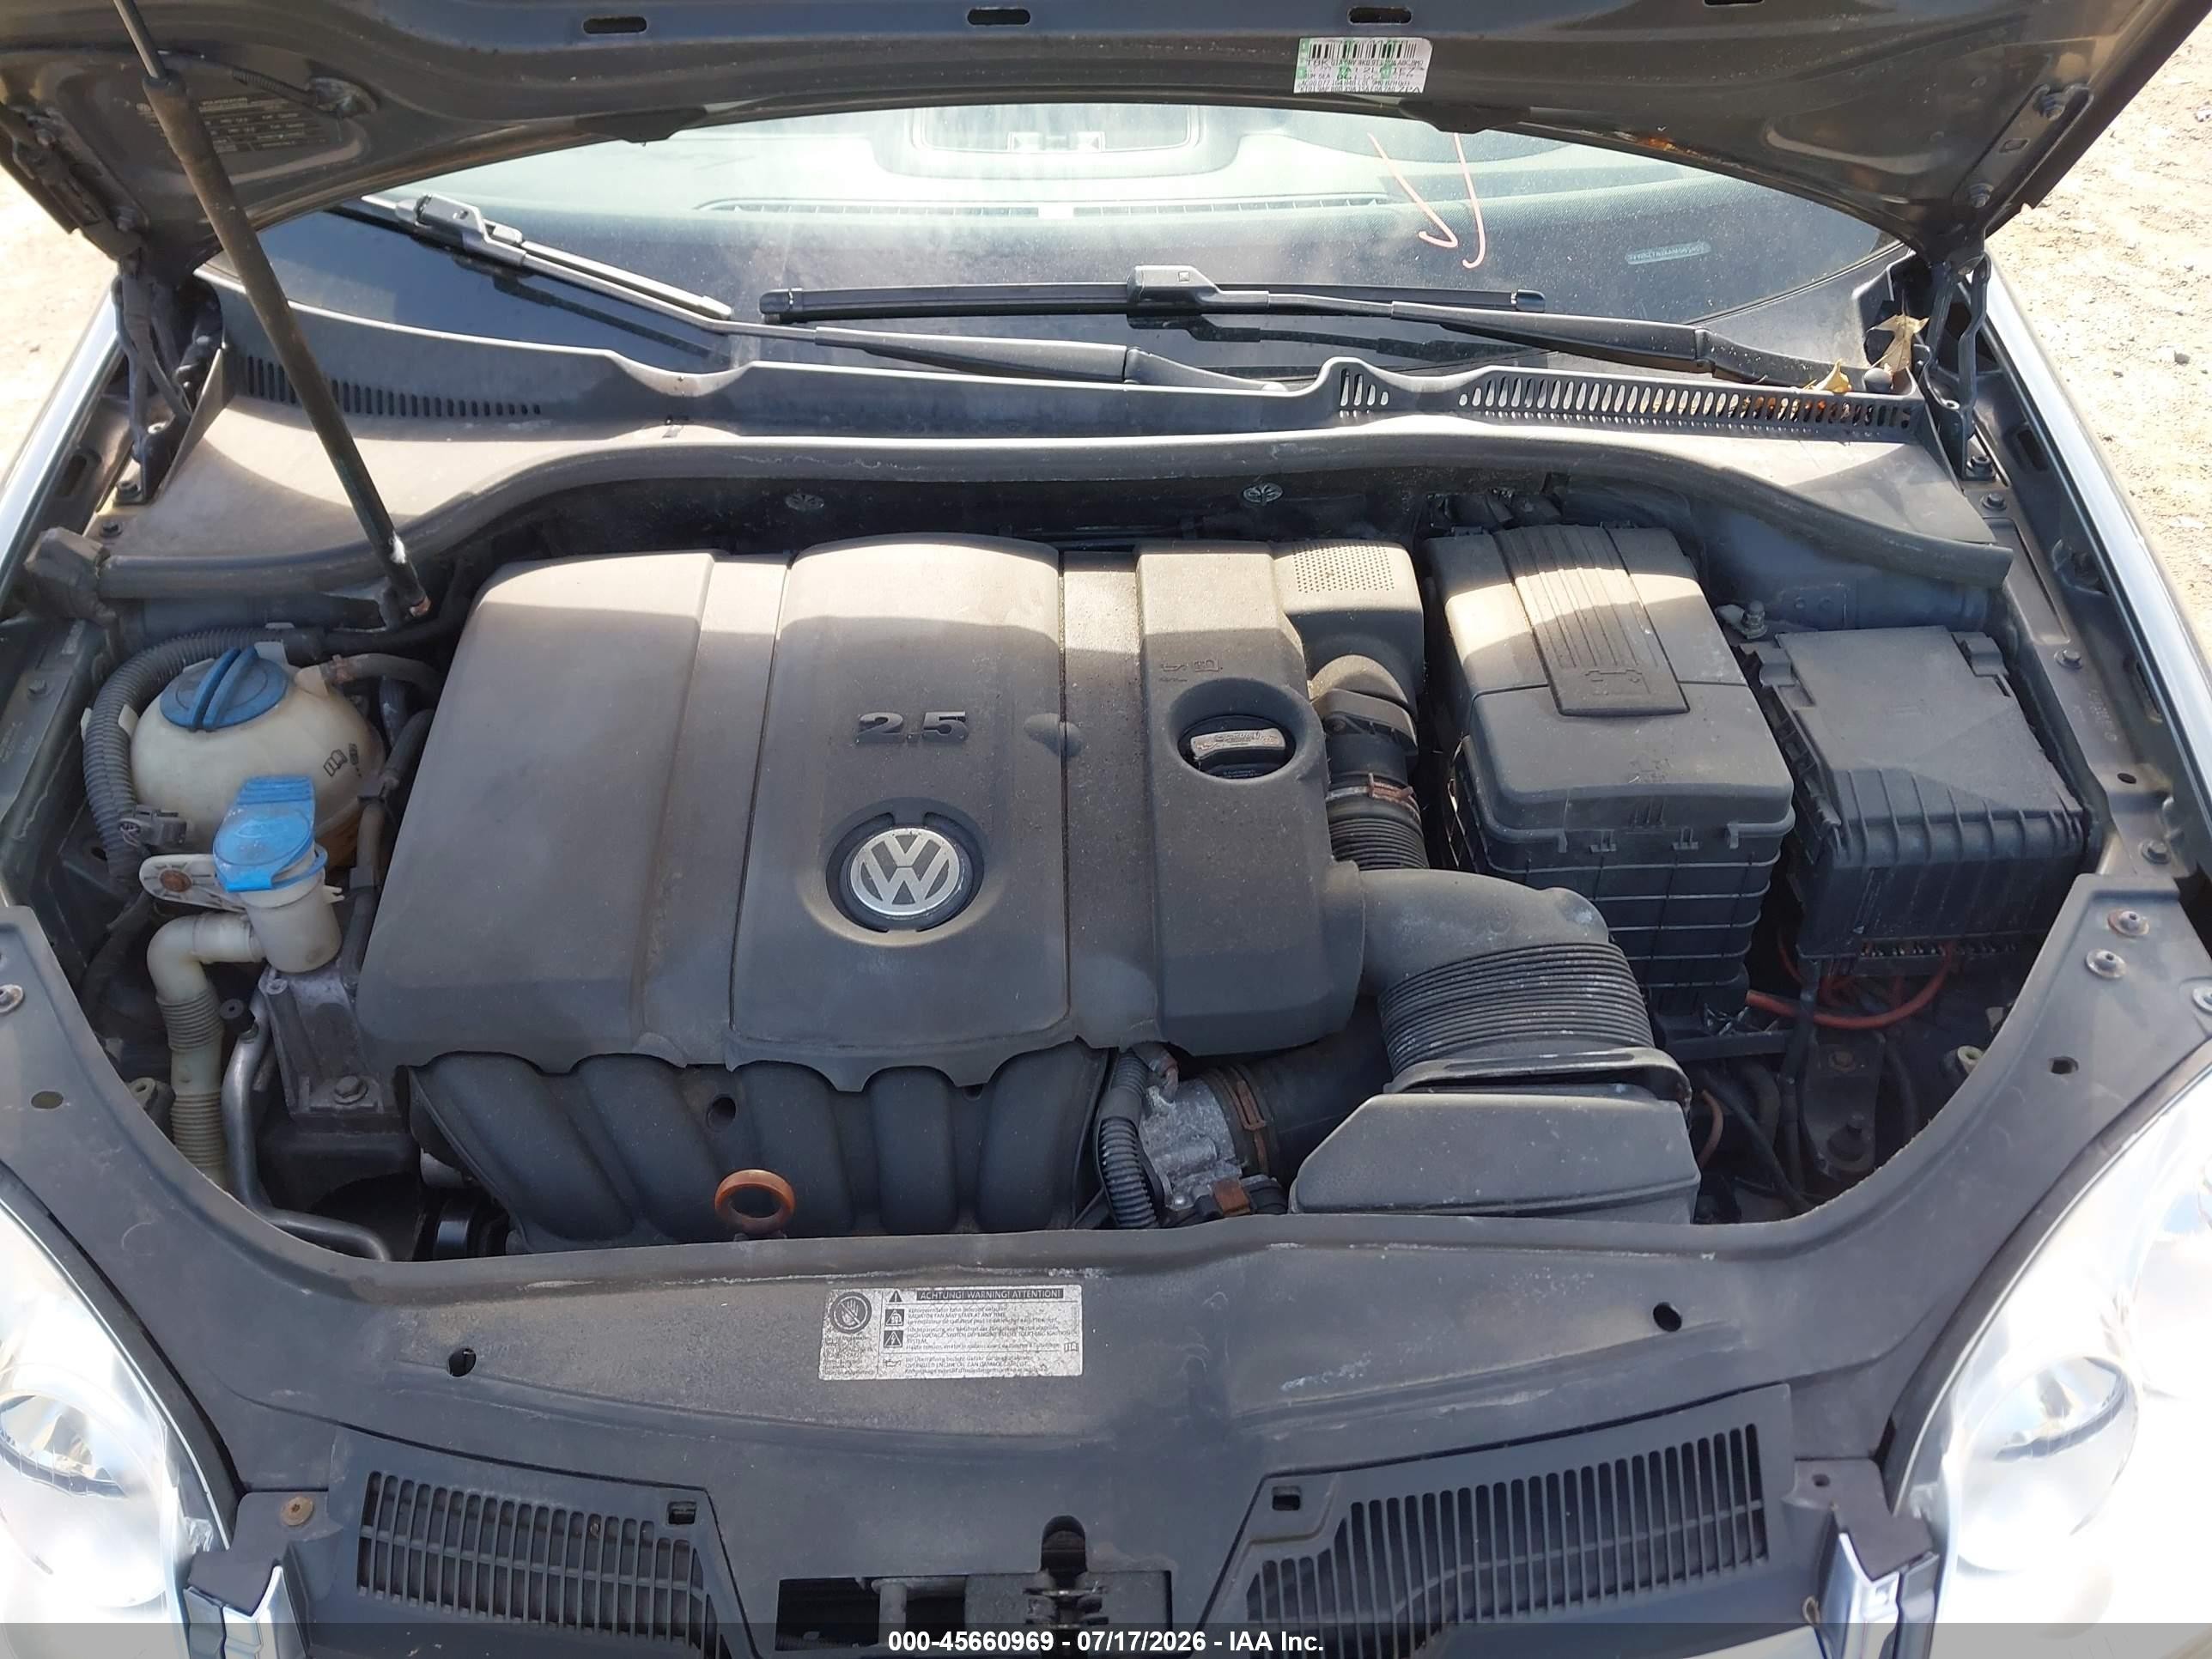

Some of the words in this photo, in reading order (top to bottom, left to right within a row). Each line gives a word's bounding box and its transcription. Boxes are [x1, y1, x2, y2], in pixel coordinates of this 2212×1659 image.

[855, 711, 969, 744] 2.5
[851, 827, 960, 916] VW
[920, 1290, 964, 1300] ACHTUNG!
[967, 1290, 1010, 1299] WARNING!
[1012, 1289, 1061, 1298] ATTENTION!
